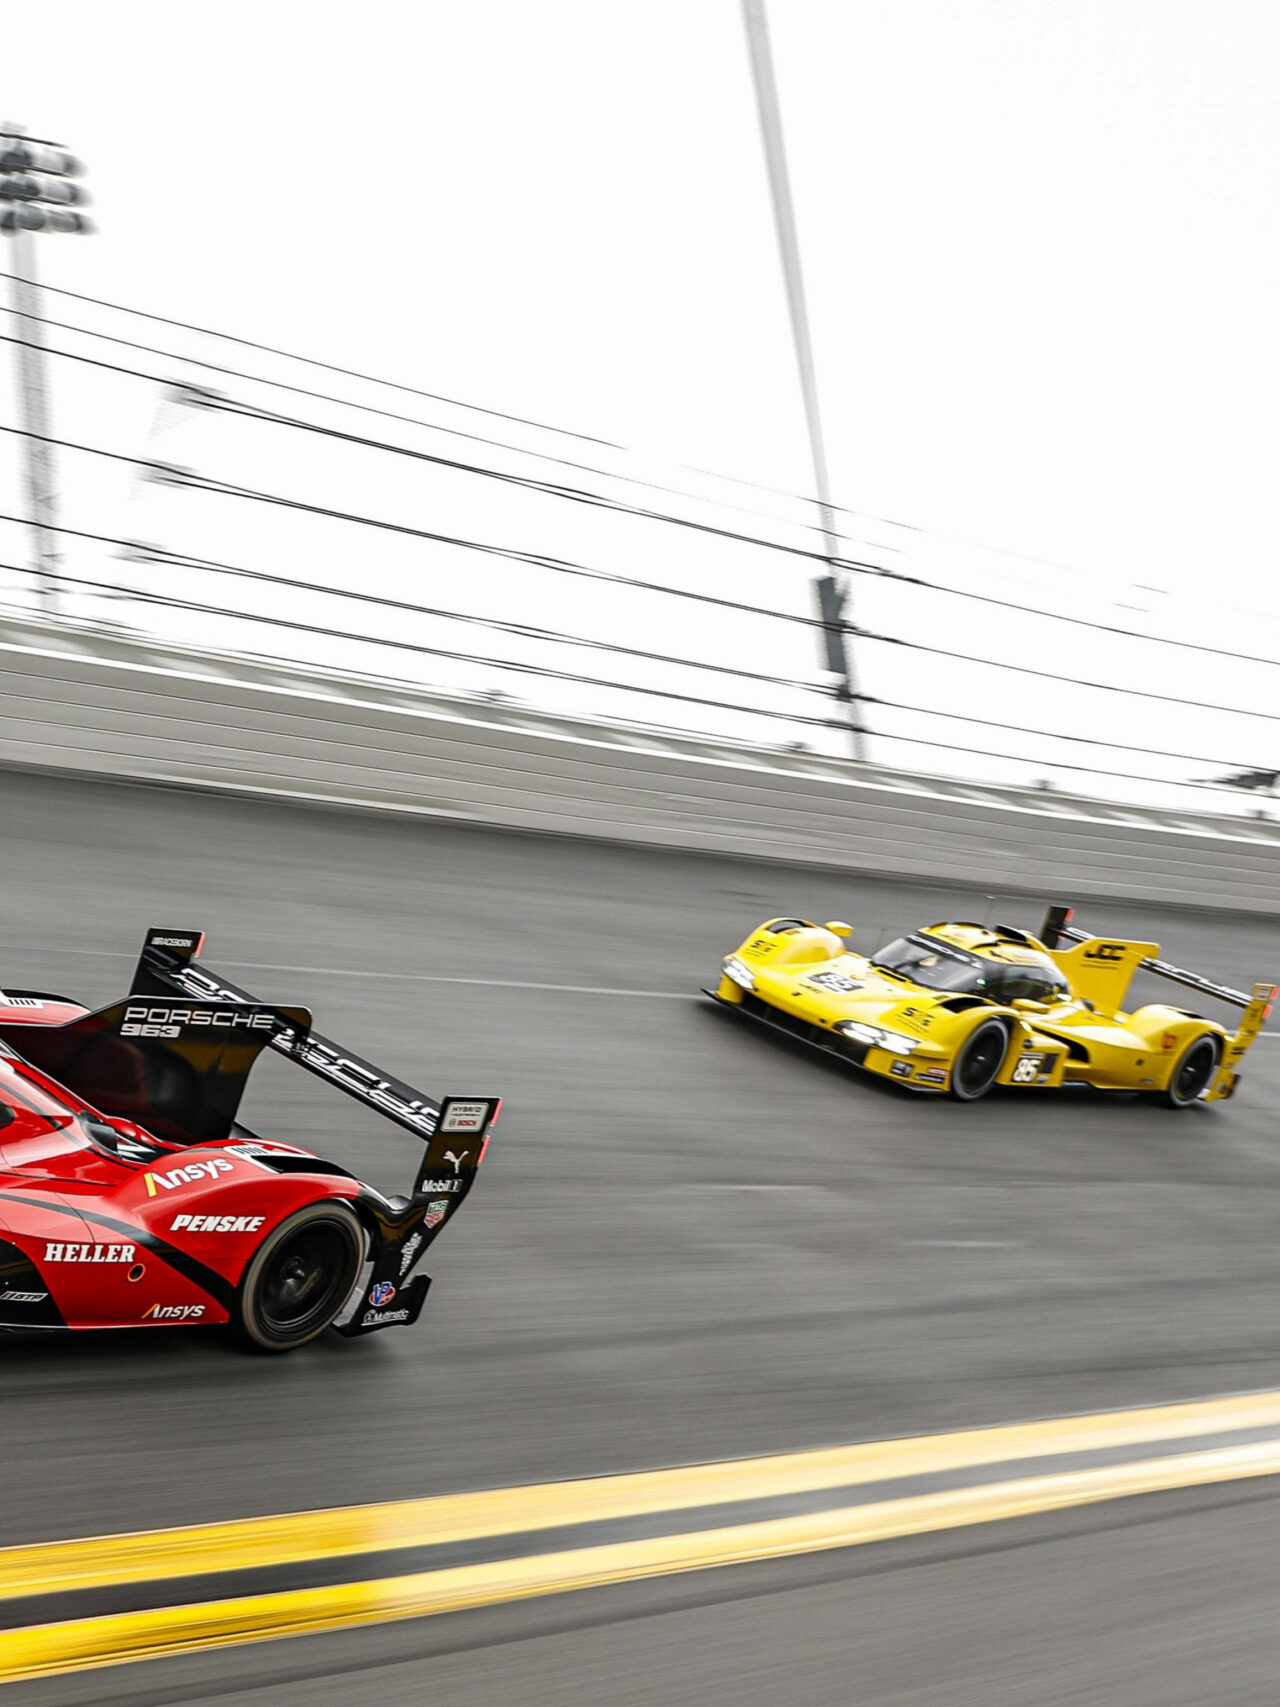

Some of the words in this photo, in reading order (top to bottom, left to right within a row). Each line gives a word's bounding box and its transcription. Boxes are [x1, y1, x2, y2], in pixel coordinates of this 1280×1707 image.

[124, 1006, 275, 1028] PORSCHE
[120, 1023, 181, 1038] 963
[1013, 1058, 1042, 1083] 85
[451, 1105, 482, 1113] HYBRID
[144, 1158, 235, 1198] Ansys
[422, 1179, 451, 1193] Mobil
[170, 1214, 266, 1232] PENSKE
[43, 1243, 136, 1263] HELLER
[141, 1303, 205, 1320] Ansys
